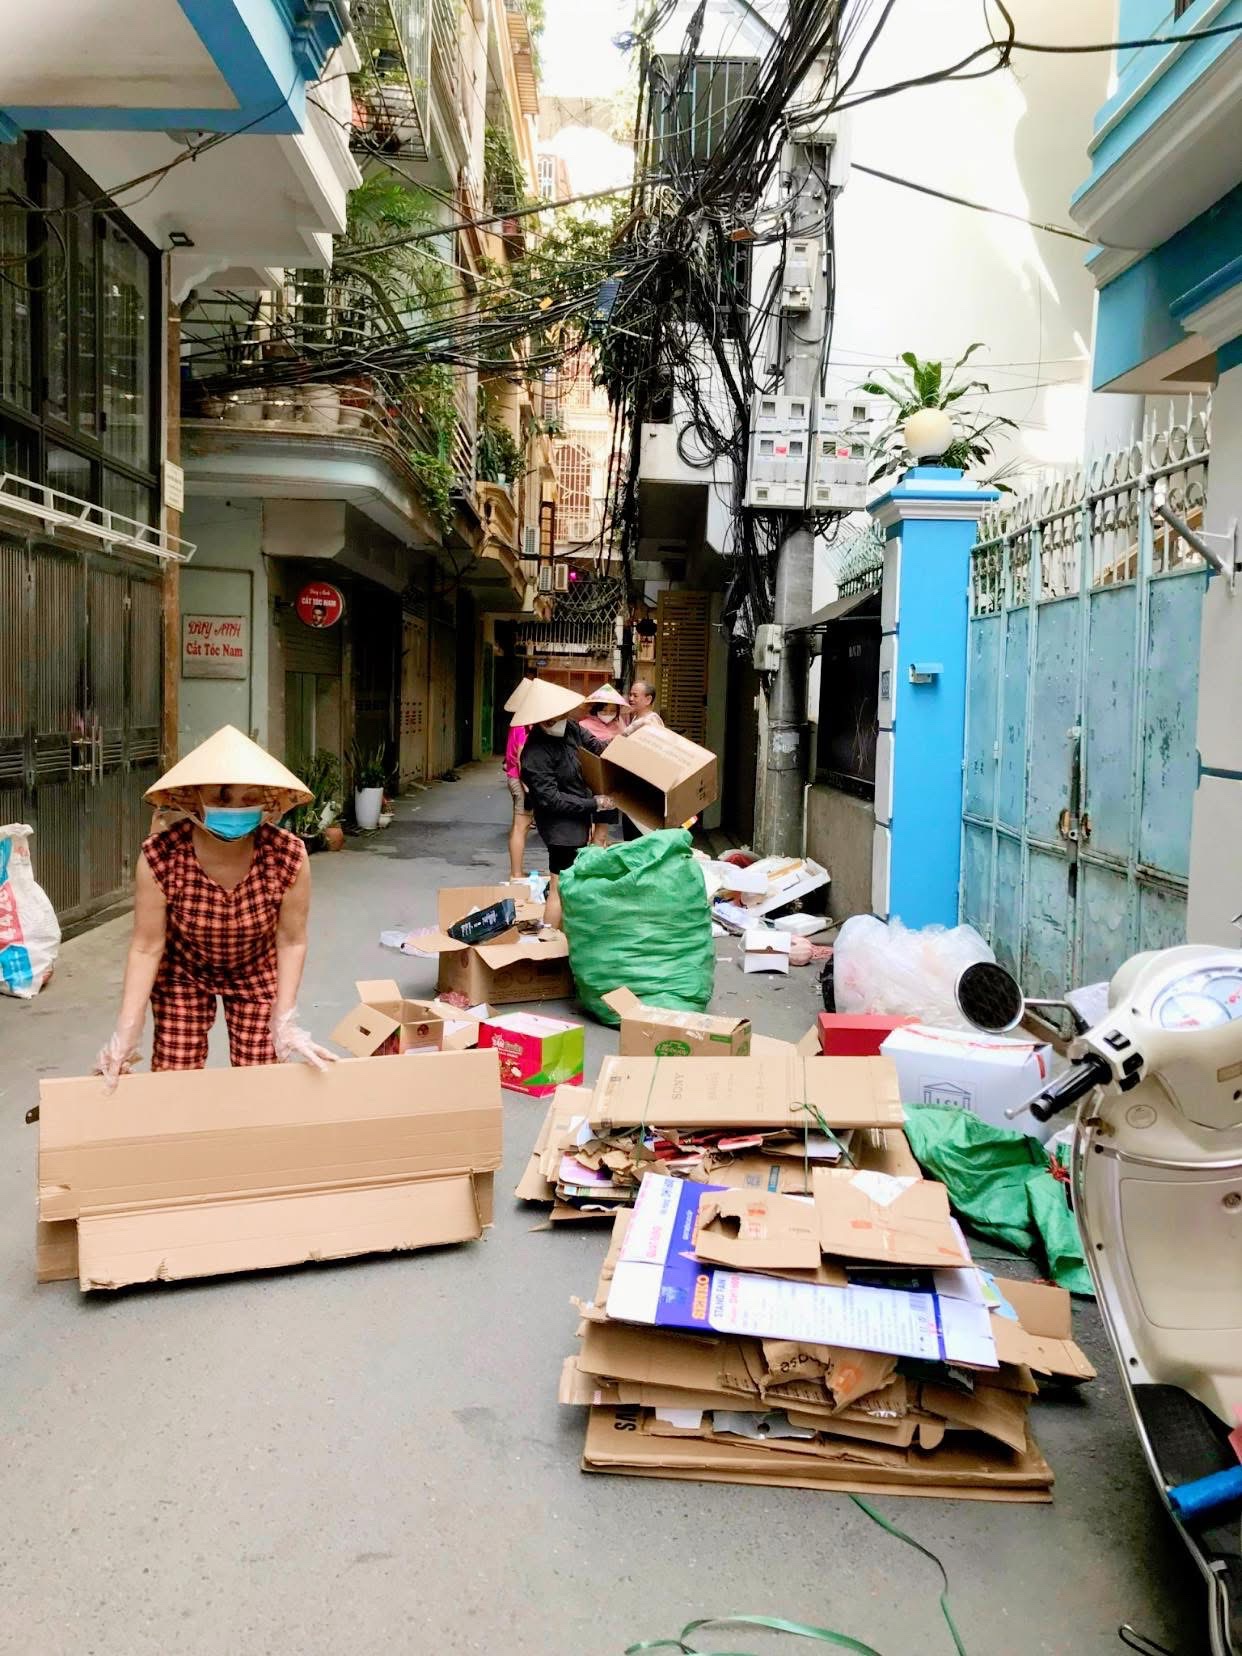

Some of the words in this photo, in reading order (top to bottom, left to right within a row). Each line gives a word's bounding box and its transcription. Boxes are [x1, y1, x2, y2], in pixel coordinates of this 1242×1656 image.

[186, 640, 202, 656] Cắt
[204, 643, 220, 656] Tóc
[222, 644, 243, 657] Nam
[672, 1073, 685, 1100] SONY
[716, 1278, 727, 1293] FAN
[714, 1292, 725, 1318] STAND
